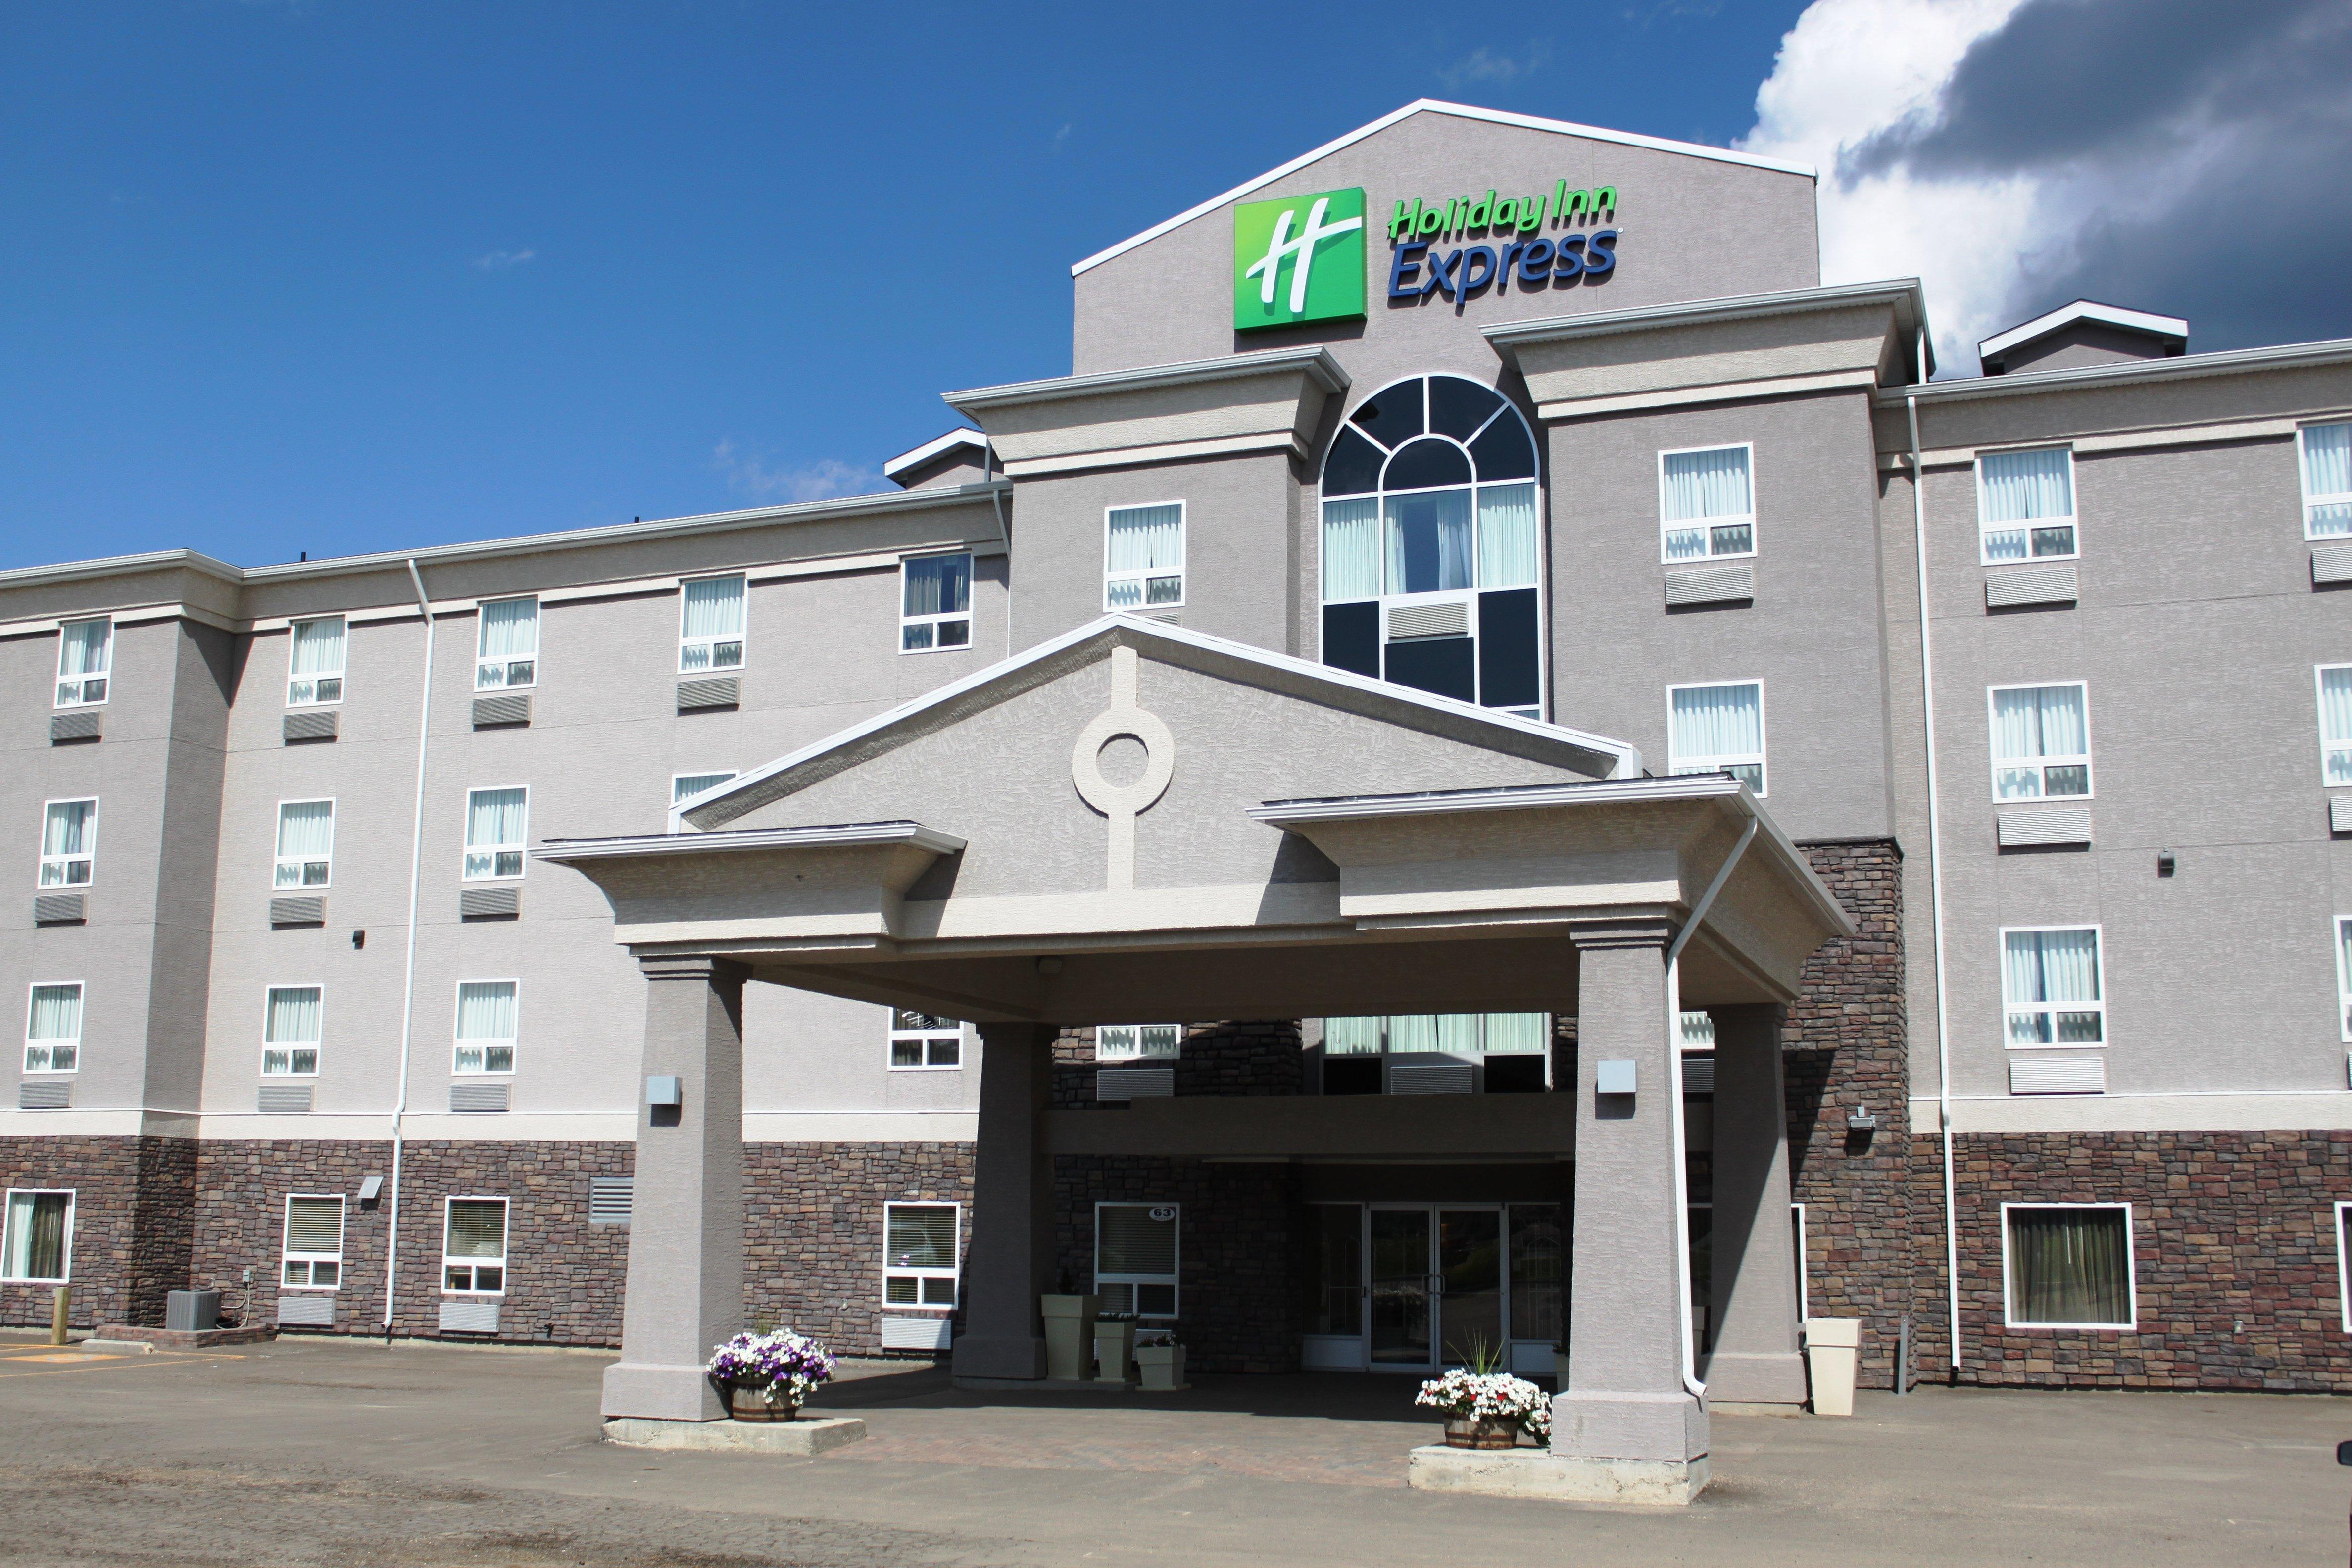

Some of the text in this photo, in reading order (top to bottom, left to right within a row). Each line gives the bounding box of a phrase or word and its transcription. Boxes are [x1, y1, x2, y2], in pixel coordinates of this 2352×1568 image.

[1387, 179, 1617, 239] Holiday Inn
[1245, 197, 1362, 313] H
[1388, 230, 1617, 305] Express
[1153, 1208, 1171, 1217] 63
